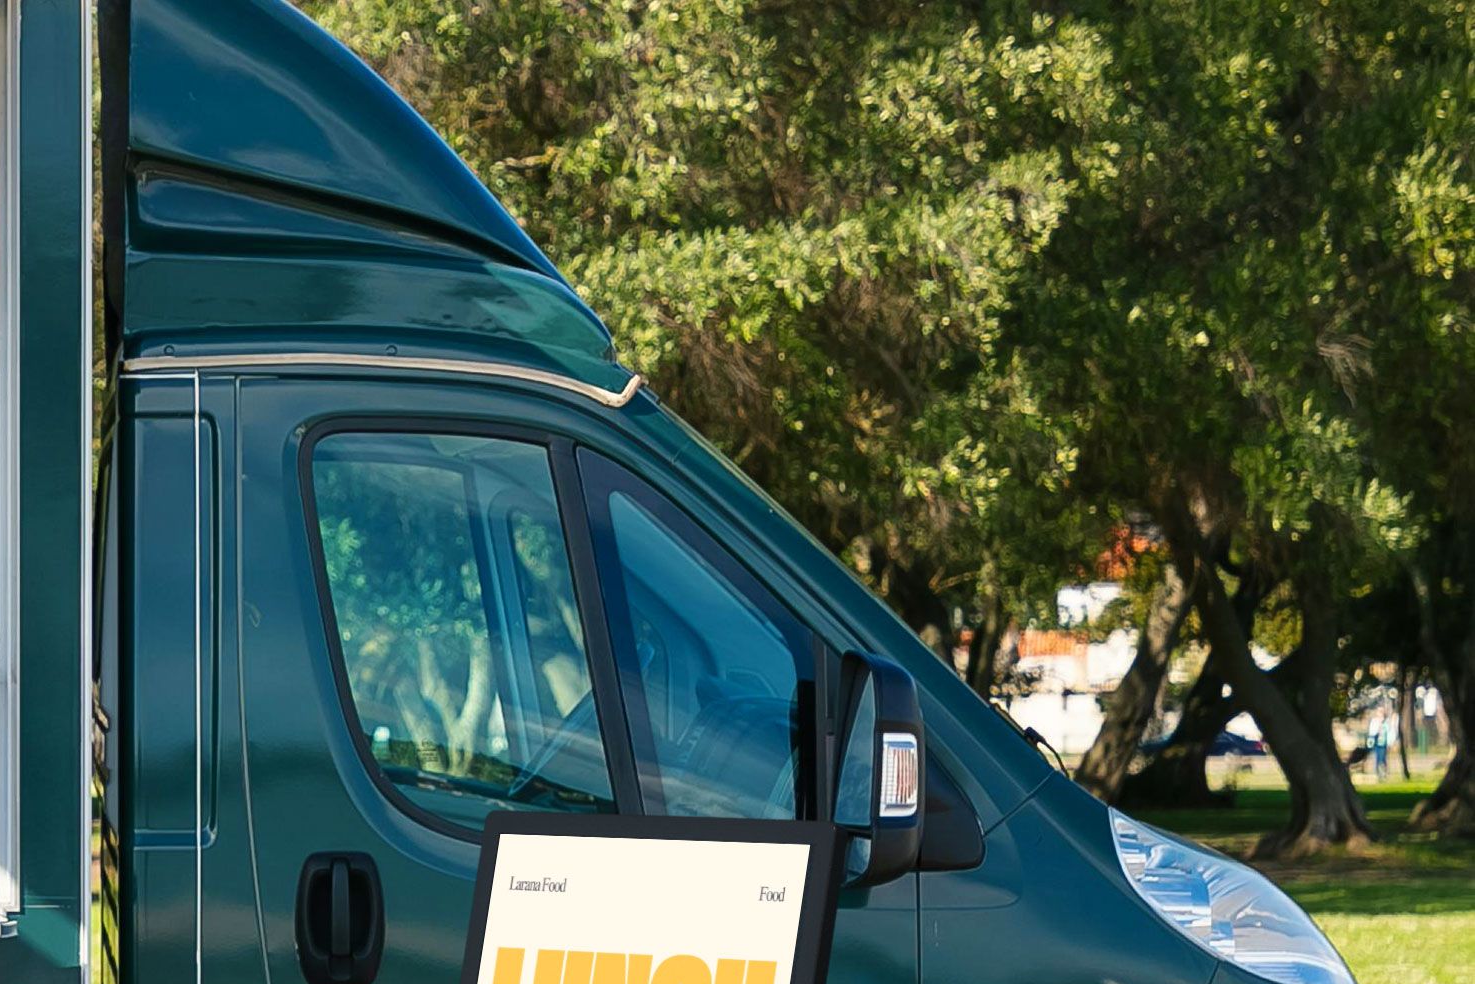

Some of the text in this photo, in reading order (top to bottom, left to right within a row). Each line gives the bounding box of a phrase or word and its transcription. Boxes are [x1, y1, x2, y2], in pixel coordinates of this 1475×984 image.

[509, 875, 567, 893] Larana Food
[758, 886, 786, 903] Food
